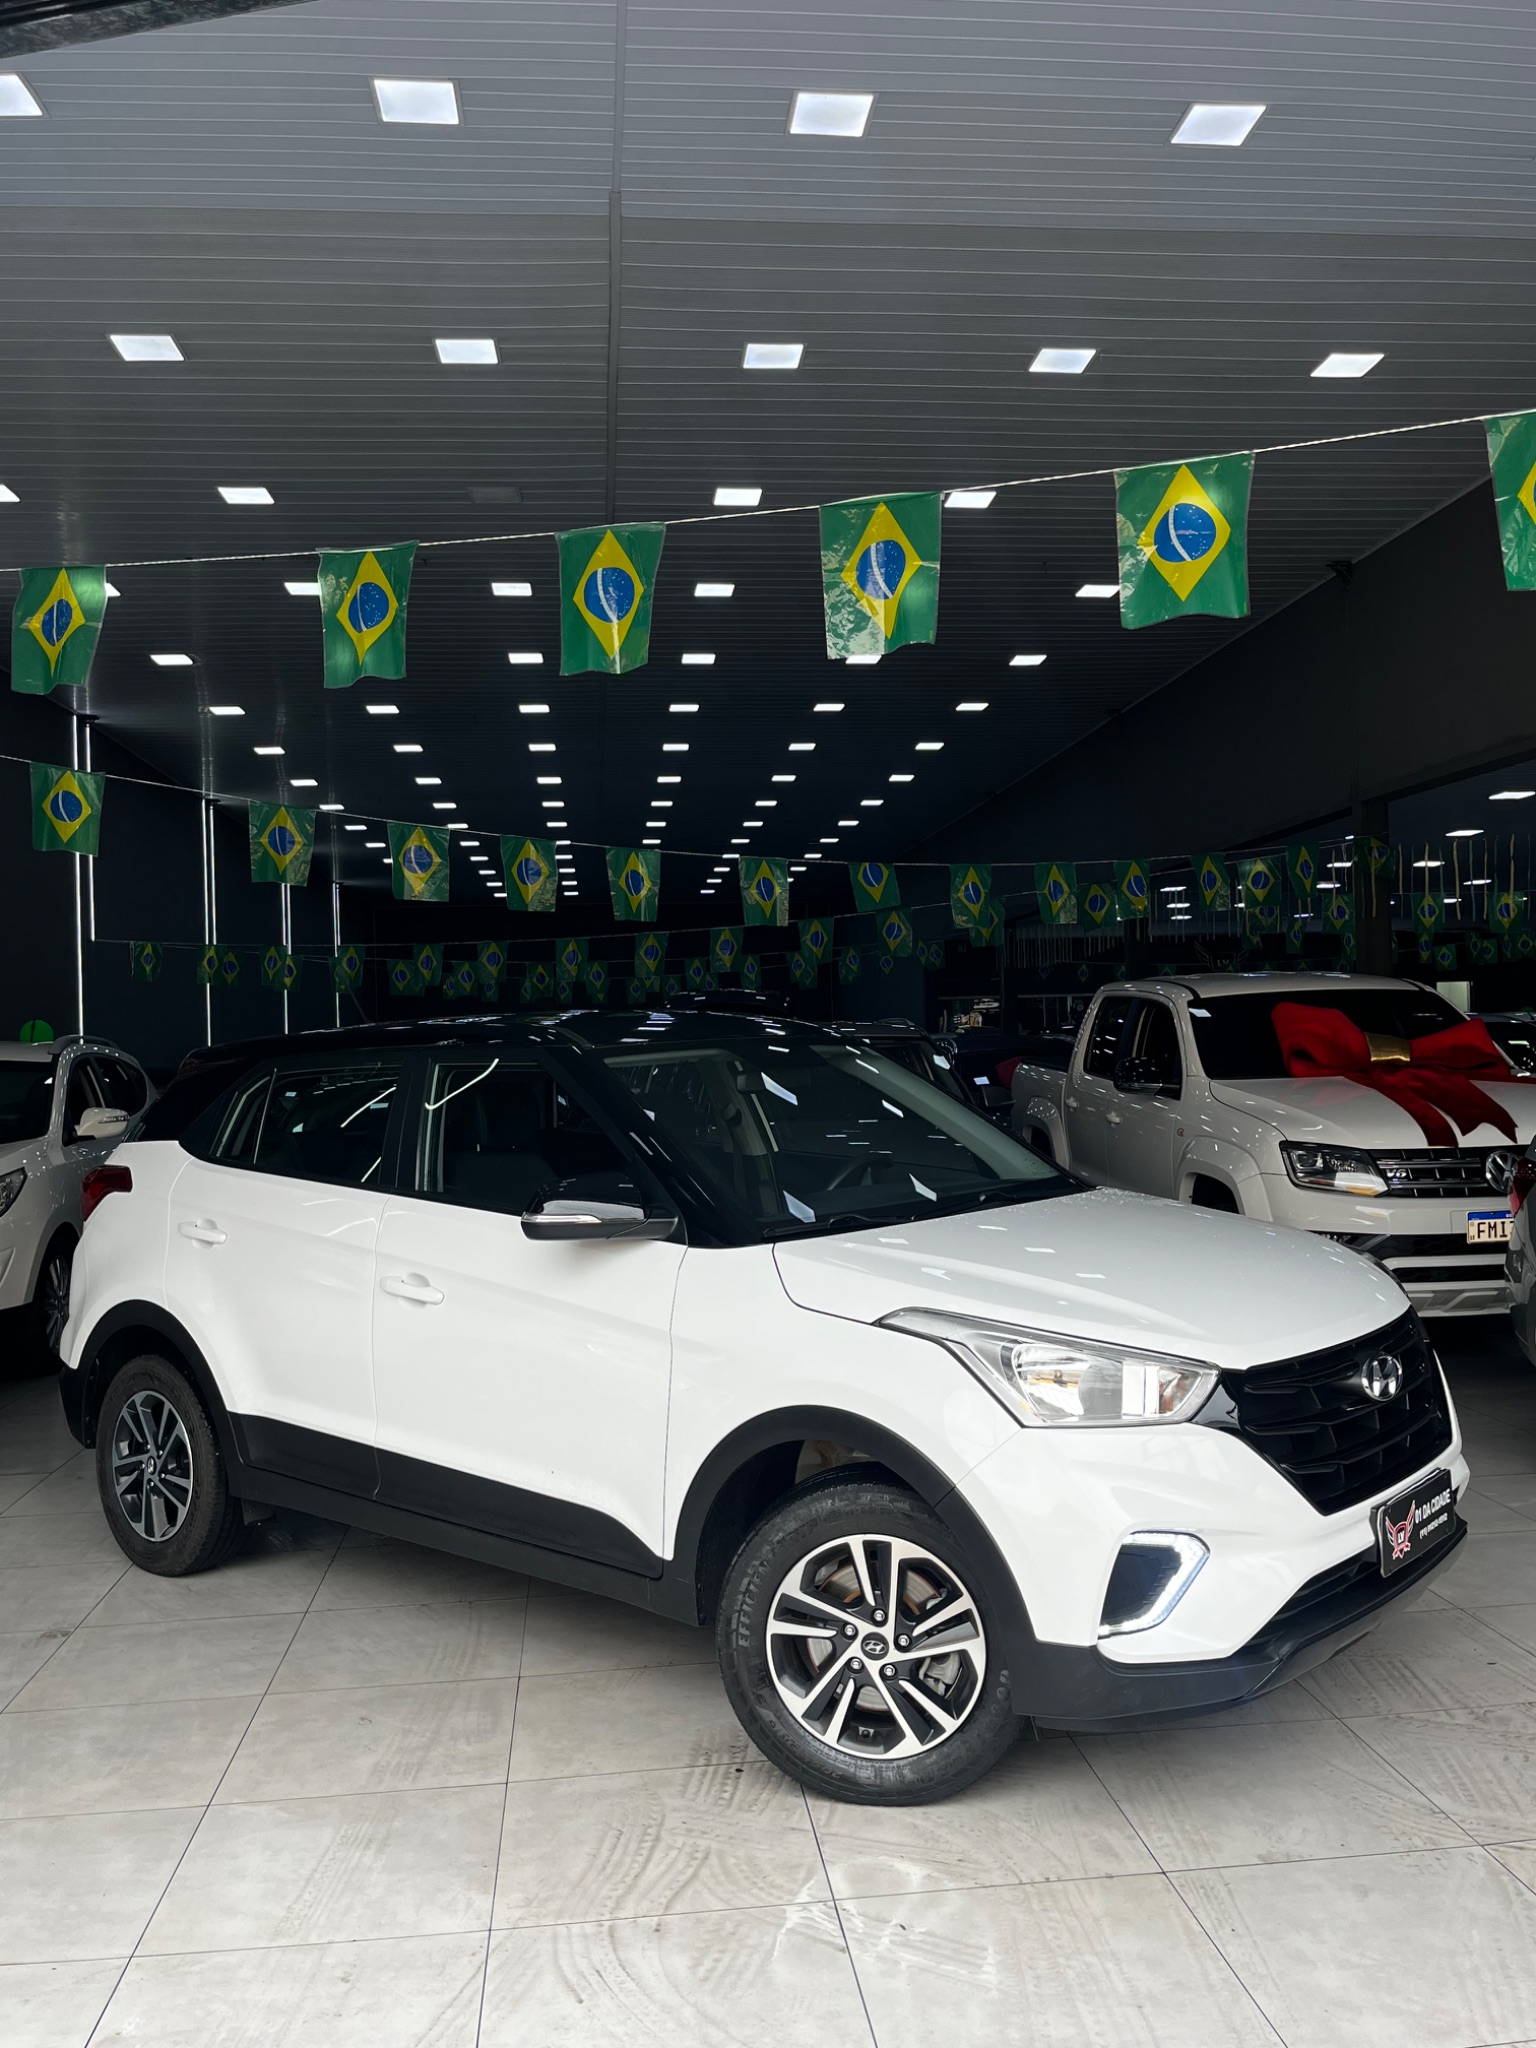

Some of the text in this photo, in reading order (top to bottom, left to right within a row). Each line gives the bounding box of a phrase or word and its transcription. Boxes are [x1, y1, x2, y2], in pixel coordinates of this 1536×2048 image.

[1386, 1168, 1407, 1178] V6
[1477, 1220, 1514, 1239] FMI
[1414, 1488, 1451, 1524] 01 DA CIDADE
